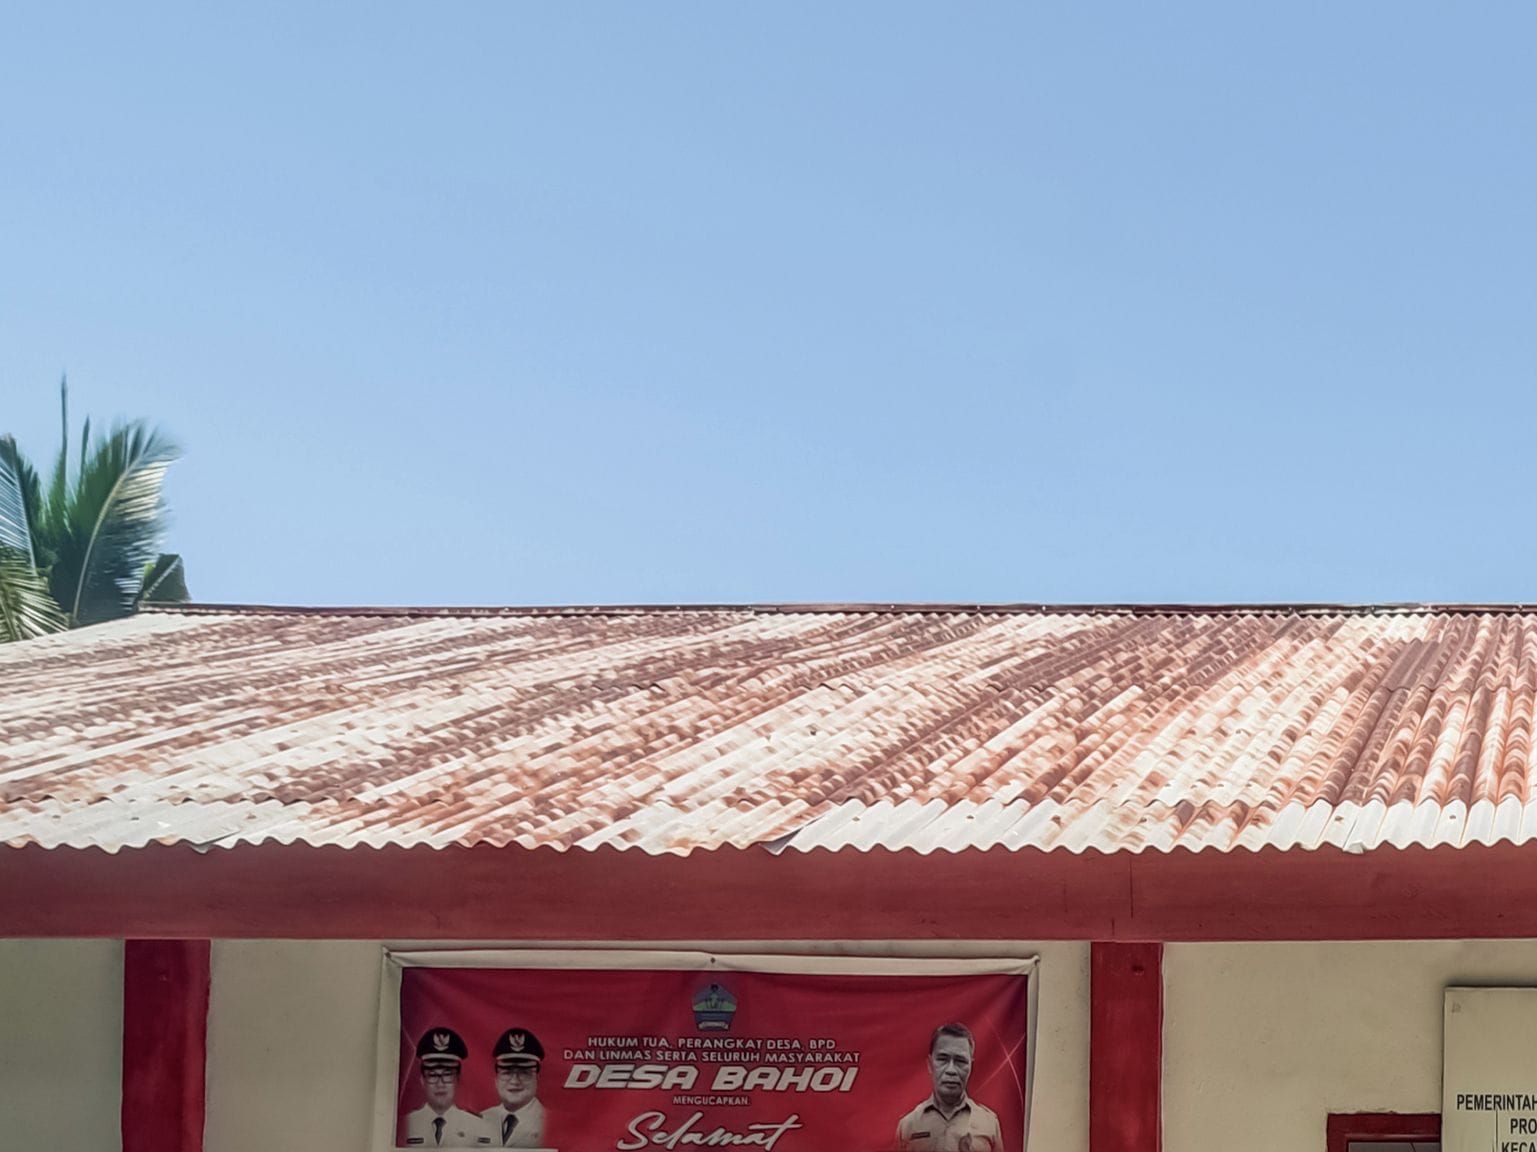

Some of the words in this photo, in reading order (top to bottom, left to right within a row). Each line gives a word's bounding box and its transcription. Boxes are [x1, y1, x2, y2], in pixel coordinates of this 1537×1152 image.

[588, 1037, 638, 1047] HUKUM
[678, 1038, 762, 1049] PERANGKAT
[810, 1039, 836, 1049] BPD
[564, 1050, 595, 1060] DAN
[600, 1050, 651, 1060] LINMAS
[656, 1050, 697, 1061] SERTA
[702, 1051, 760, 1062] SELURUH
[765, 1052, 860, 1063] MASYARAKAT
[563, 1064, 699, 1090] DESA
[711, 1066, 859, 1092] BAHOI
[617, 1111, 803, 1151] Selamat
